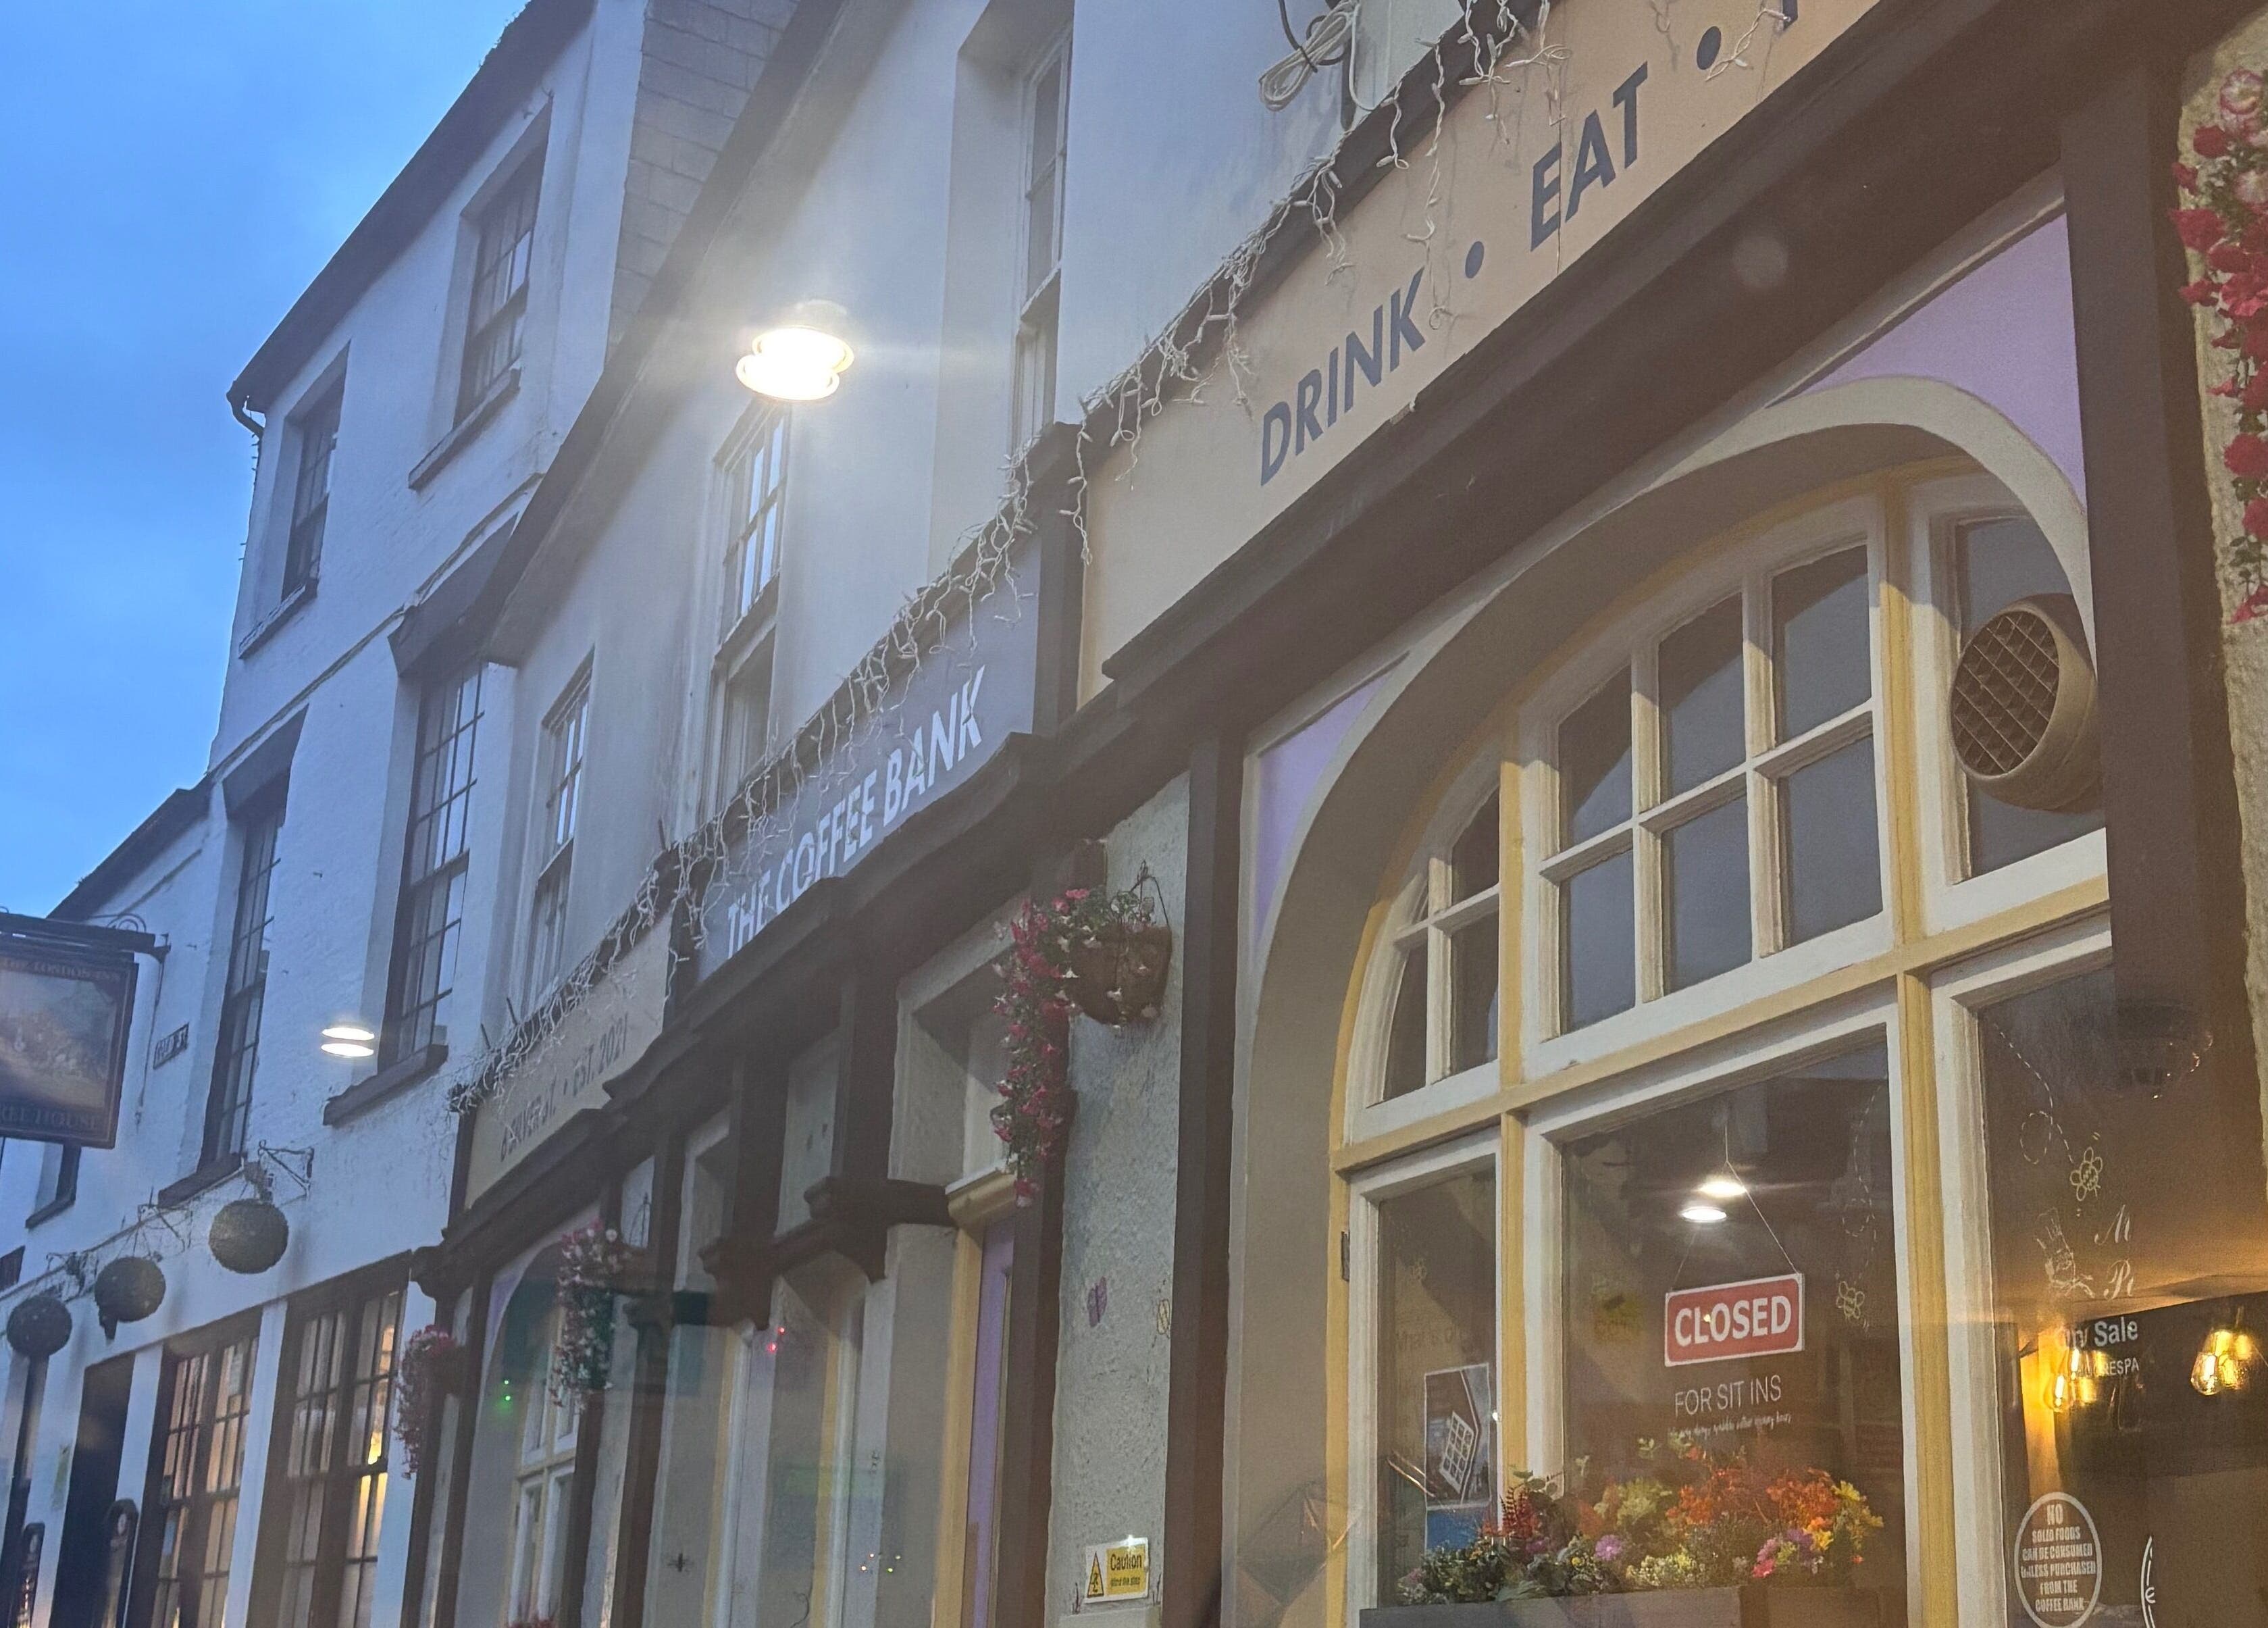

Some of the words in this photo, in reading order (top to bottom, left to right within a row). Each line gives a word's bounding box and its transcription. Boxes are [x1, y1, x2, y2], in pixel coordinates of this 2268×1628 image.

[1260, 265, 1426, 486] DRINK
[1530, 61, 1648, 252] EAT
[728, 871, 771, 959] THE
[776, 769, 877, 914] COFFEE
[883, 665, 985, 827] BANK
[1674, 1295, 1790, 1346] CLOSED
[2094, 1316, 2138, 1346] Sale
[1674, 1387, 1712, 1417] FOR
[1717, 1380, 1745, 1410] SIT
[1750, 1375, 1782, 1405] INS
[2046, 1504, 2063, 1525] NO
[2032, 1528, 2054, 1544] SOLID
[2055, 1526, 2081, 1541] FOODS
[1110, 1553, 1142, 1571] Caution
[2022, 1547, 2038, 1561] CAN
[2039, 1546, 2049, 1560] BE
[2050, 1543, 2093, 1558] CONSUMED
[2021, 1563, 2048, 1579] UNLESS
[2050, 1560, 2096, 1577] PURCHASED
[2040, 1581, 2061, 1596] FROM
[2063, 1579, 2078, 1594] THE
[2035, 1598, 2062, 1612] COFFEE
[2063, 1597, 2085, 1612] BANK
